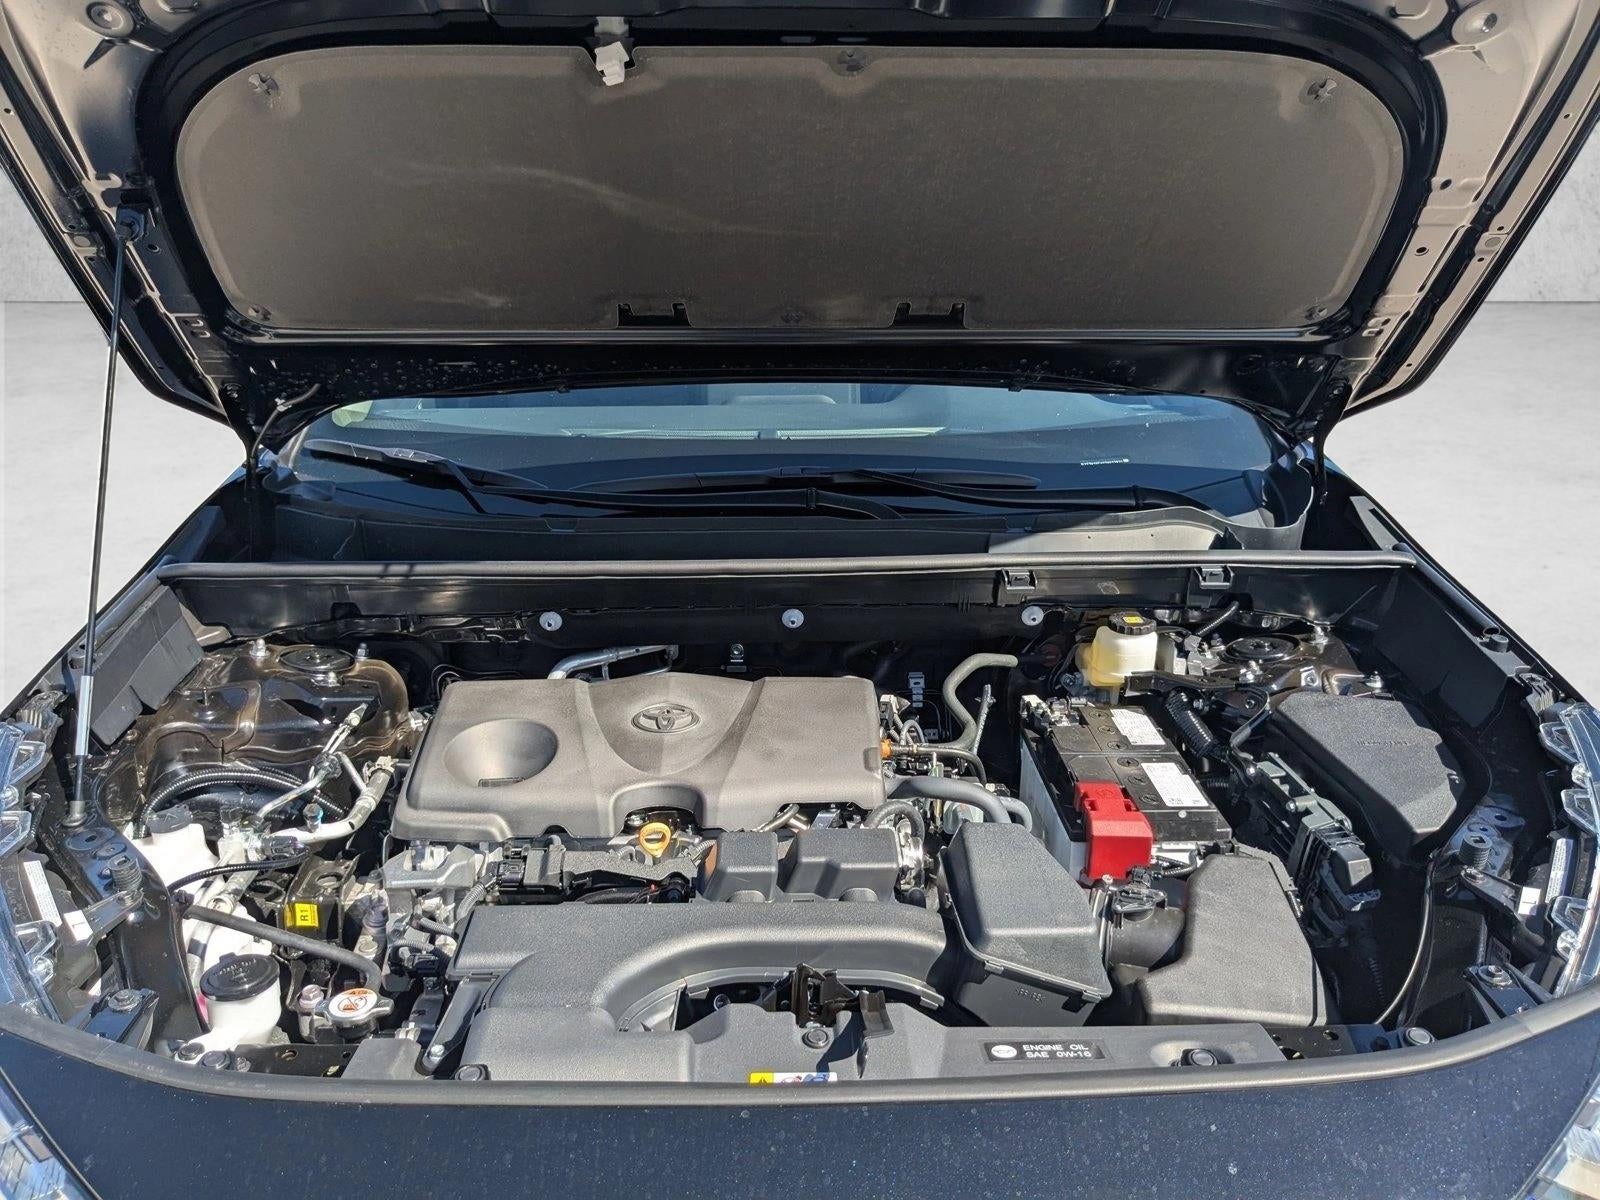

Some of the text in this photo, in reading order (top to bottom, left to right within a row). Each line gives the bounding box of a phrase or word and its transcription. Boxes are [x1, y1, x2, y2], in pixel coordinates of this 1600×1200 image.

[300, 909, 309, 922] R1
[1069, 1043, 1090, 1051] OIL
[1056, 1050, 1092, 1058] 0W-16
